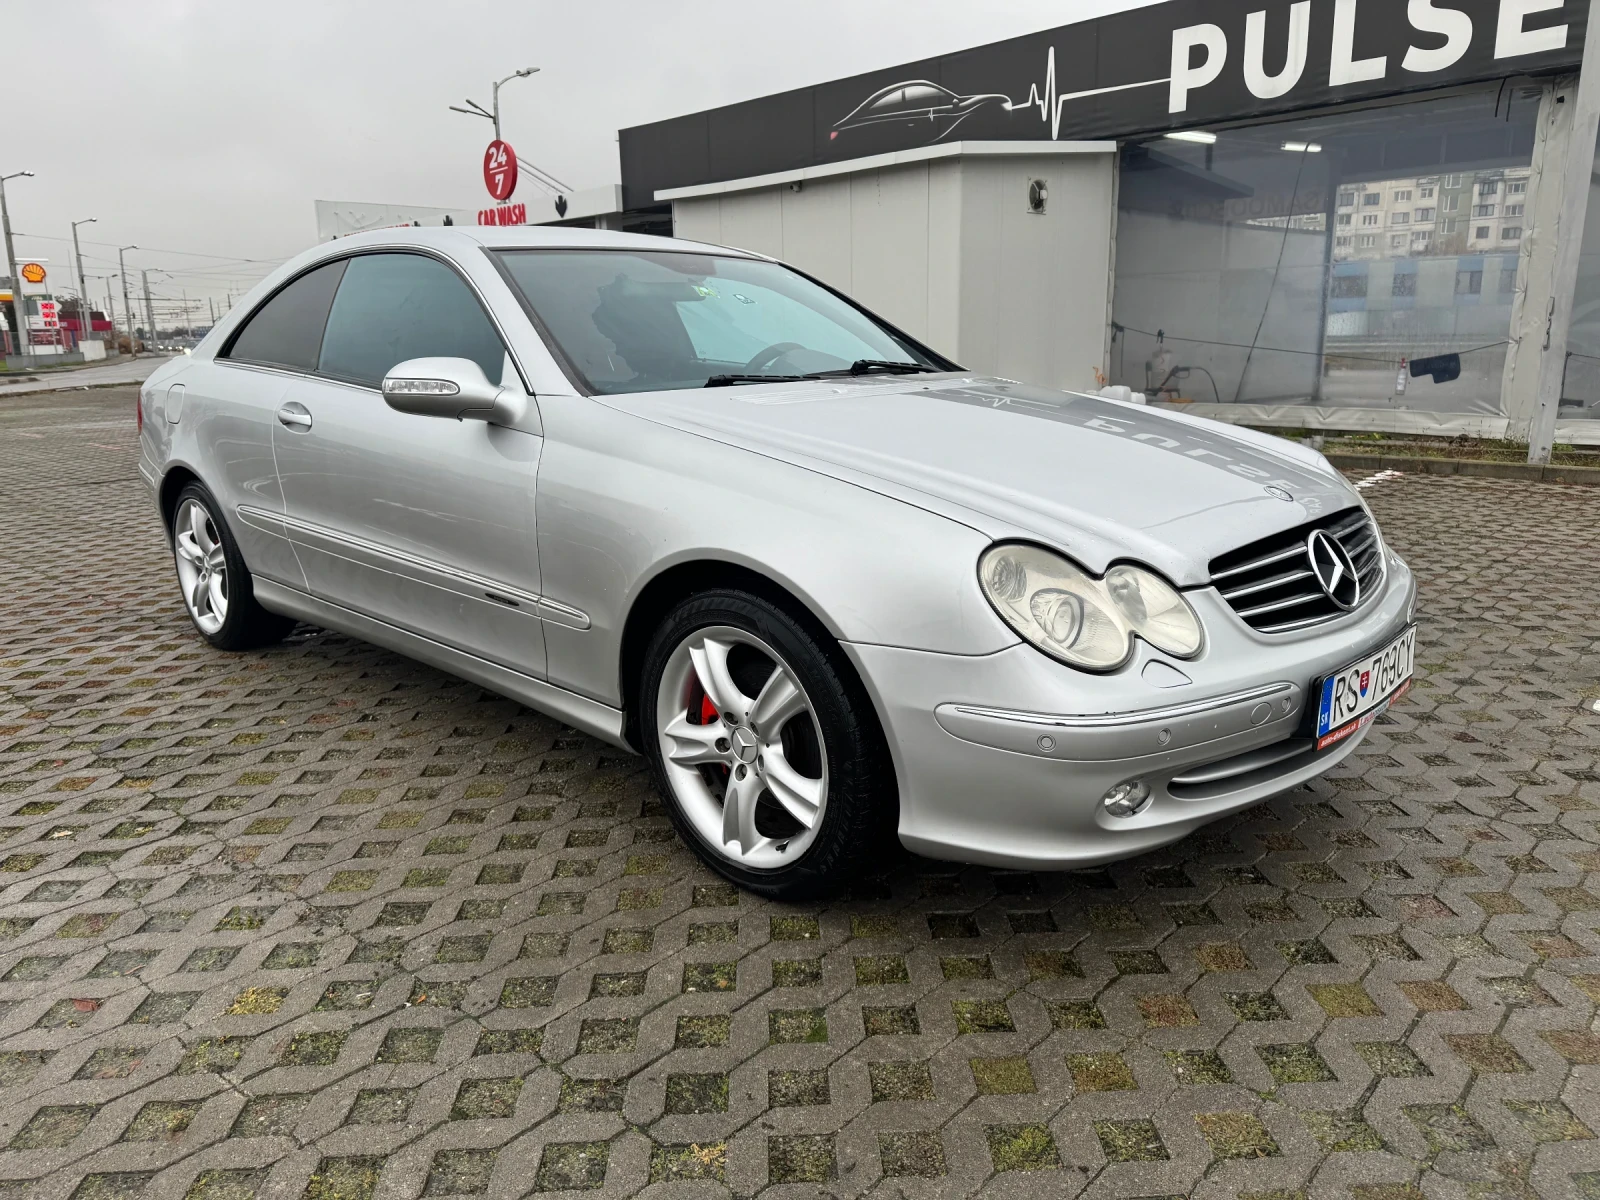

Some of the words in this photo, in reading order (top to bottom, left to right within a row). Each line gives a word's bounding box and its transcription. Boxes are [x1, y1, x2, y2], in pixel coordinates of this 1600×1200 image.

[1168, 0, 1569, 113] PULSE
[489, 144, 507, 169] 24
[495, 173, 504, 195] 7
[478, 209, 497, 226] CAR
[497, 203, 526, 227] WASH
[1333, 668, 1360, 723] RS
[1320, 711, 1329, 726] SK
